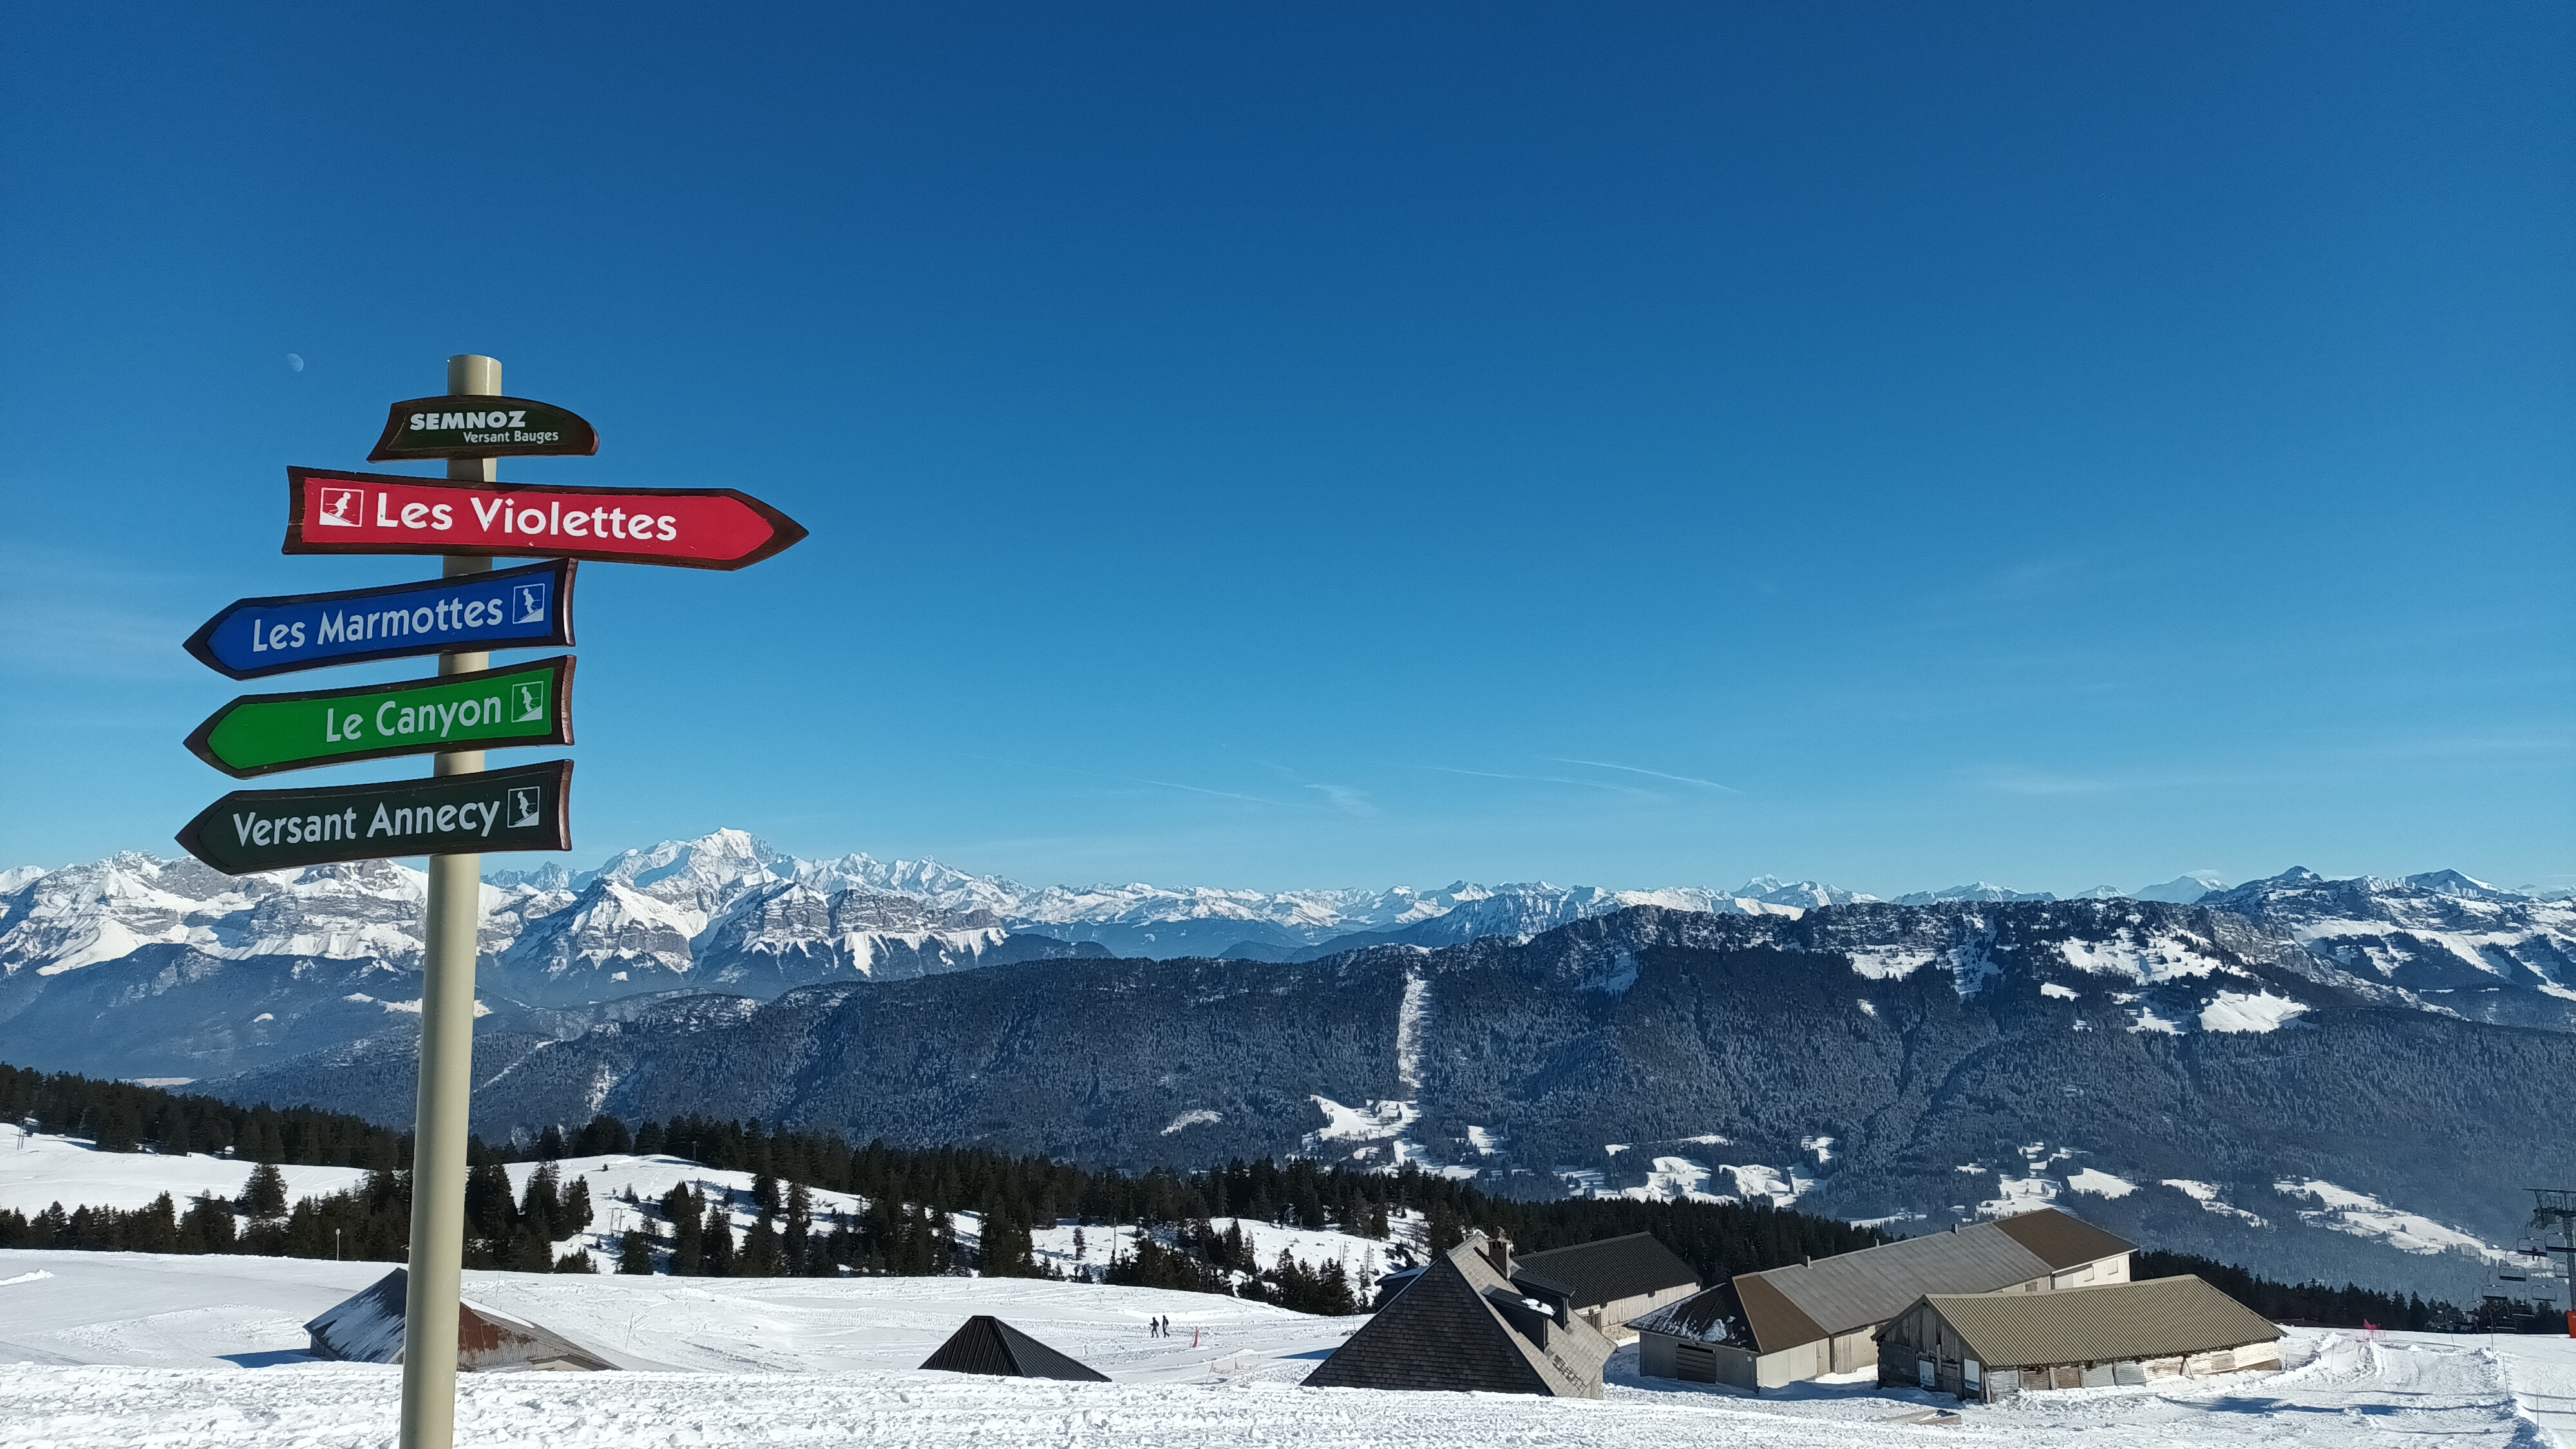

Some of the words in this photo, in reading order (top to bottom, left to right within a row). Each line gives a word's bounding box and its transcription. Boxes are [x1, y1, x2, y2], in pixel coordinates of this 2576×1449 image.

[410, 410, 526, 431] SEMNOZ
[463, 431, 510, 443] Versant
[514, 430, 559, 444] Bauges
[376, 492, 453, 531] Les
[469, 497, 677, 542] Violettes
[253, 619, 305, 652] Les
[317, 598, 503, 645] Marmottes
[327, 708, 362, 743] Le
[376, 696, 501, 737] Canyon
[232, 807, 357, 847] Versant
[366, 801, 500, 837] Annecy
